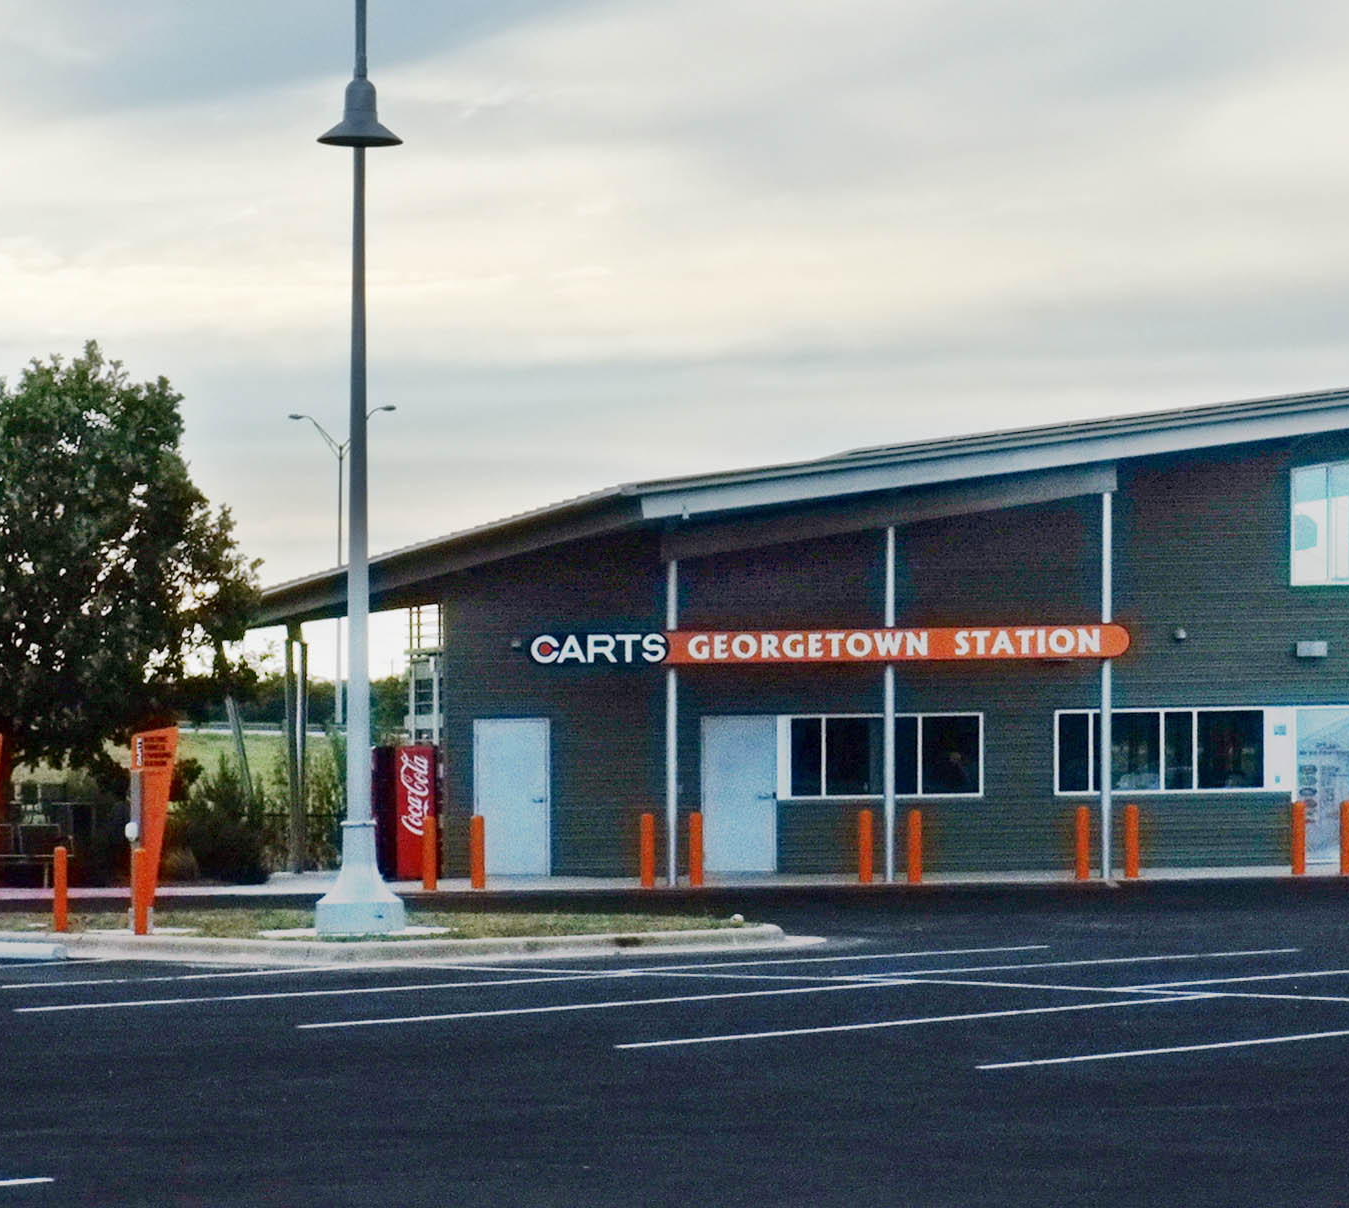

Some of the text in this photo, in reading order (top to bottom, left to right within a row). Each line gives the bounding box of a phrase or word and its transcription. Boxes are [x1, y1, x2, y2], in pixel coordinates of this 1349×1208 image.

[530, 628, 1101, 664] CARTS GEORGETOWN STATION
